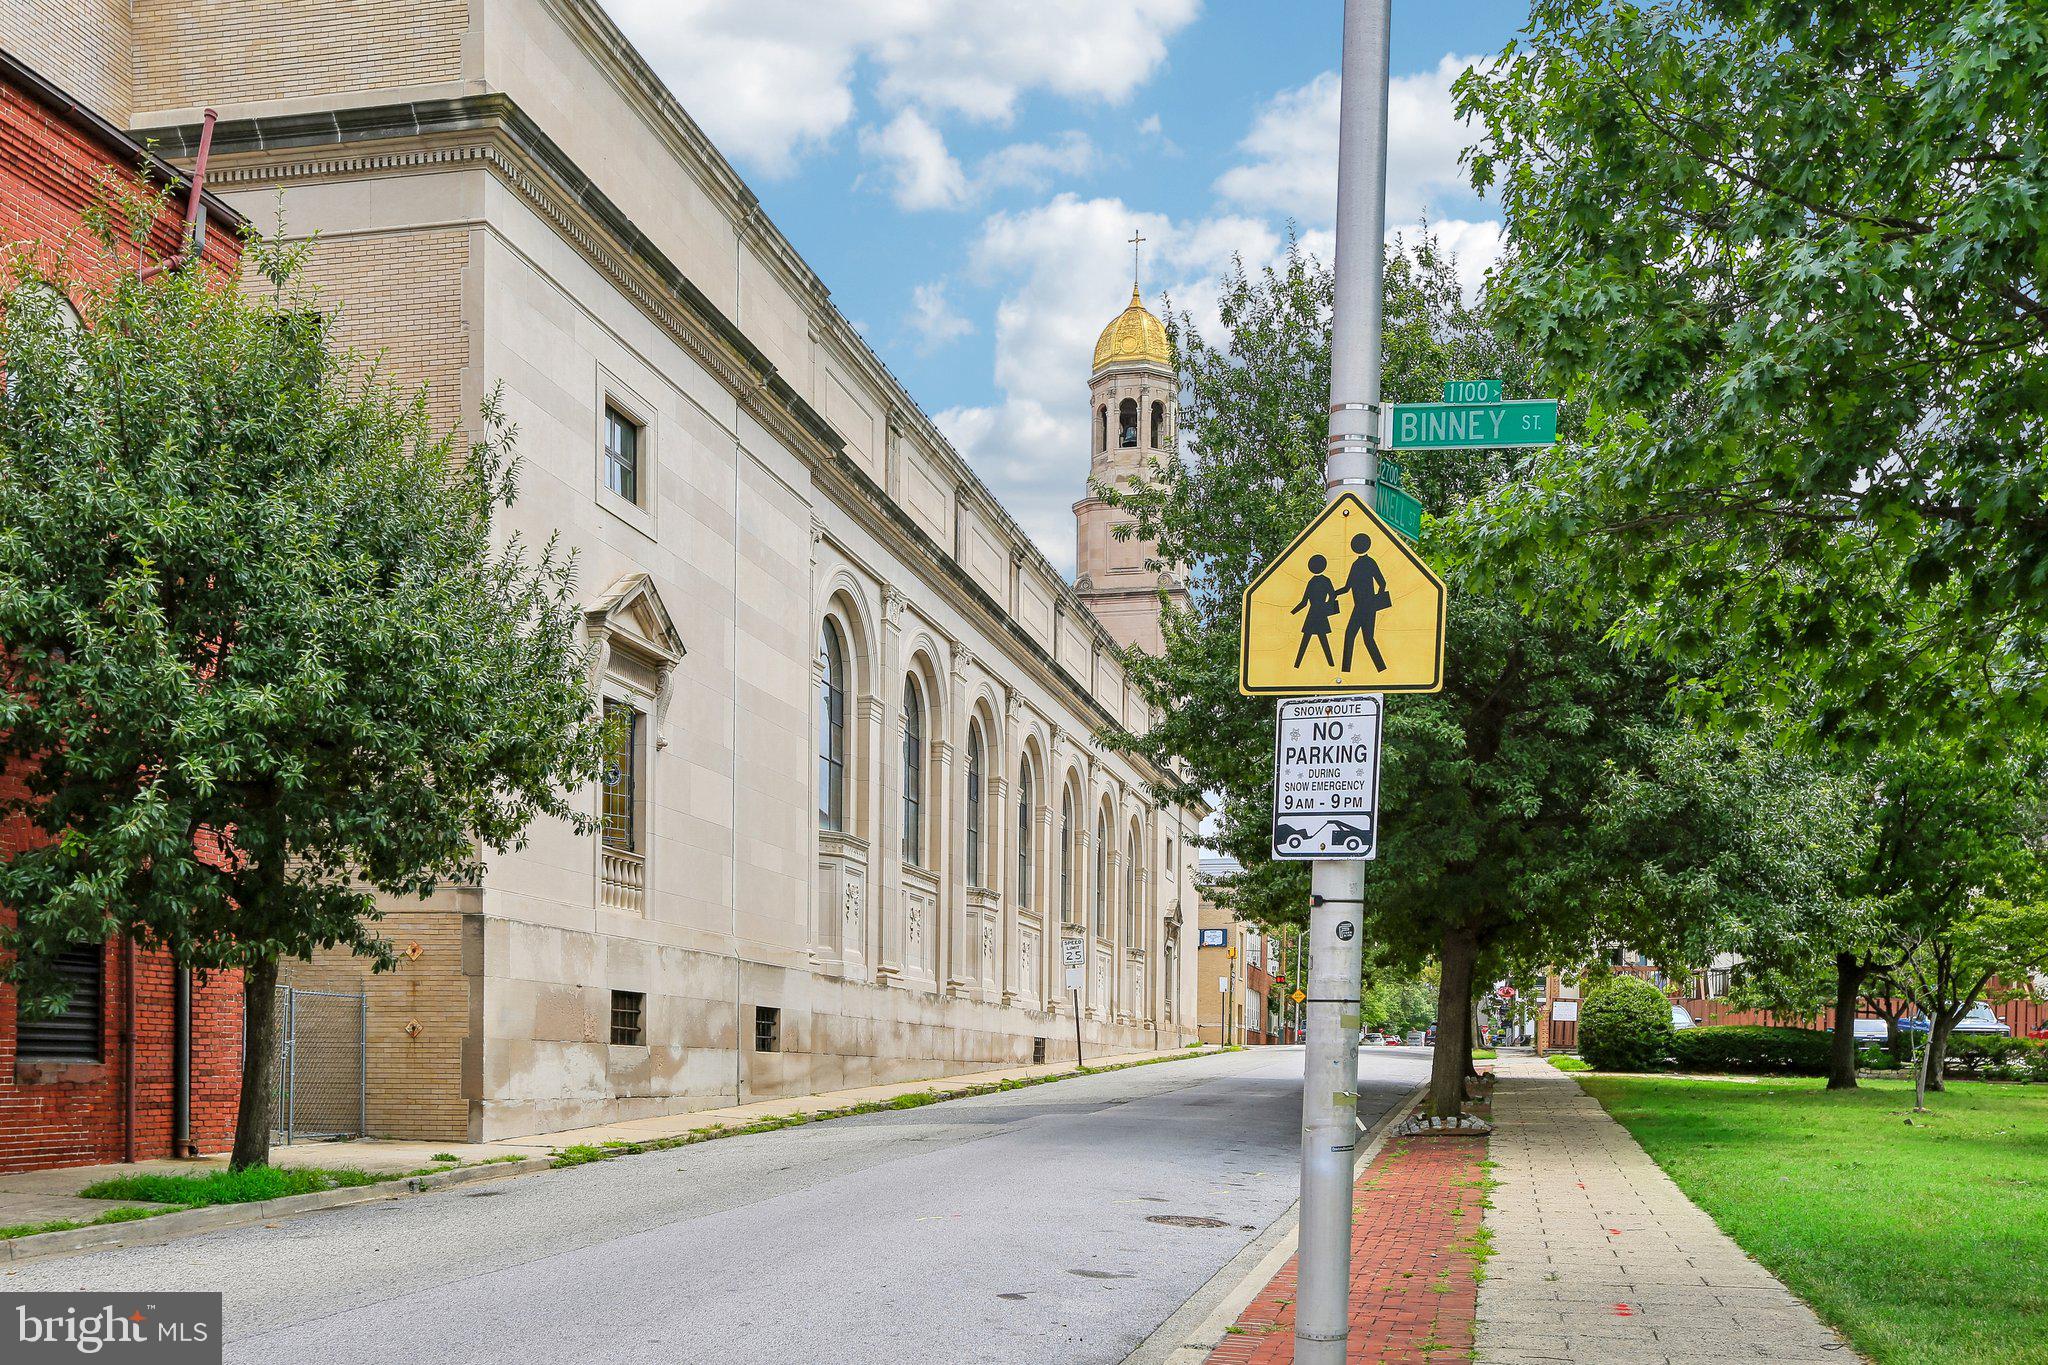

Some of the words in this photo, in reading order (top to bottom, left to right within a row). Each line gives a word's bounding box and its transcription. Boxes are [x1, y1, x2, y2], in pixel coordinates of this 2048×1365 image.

[1450, 382, 1488, 402] 1100
[1401, 410, 1506, 442] BINNEY
[1522, 415, 1542, 430] ST.
[1381, 461, 1399, 485] 2700
[1294, 706, 1324, 717] SNOW
[1325, 704, 1362, 716] ROUTE
[1313, 721, 1344, 741] NO
[1286, 744, 1367, 765] PARKING
[1308, 768, 1341, 779] DURING
[1284, 781, 1310, 792] SNOW
[1311, 780, 1365, 791] EMERGENCY
[1066, 951, 1082, 961] 25
